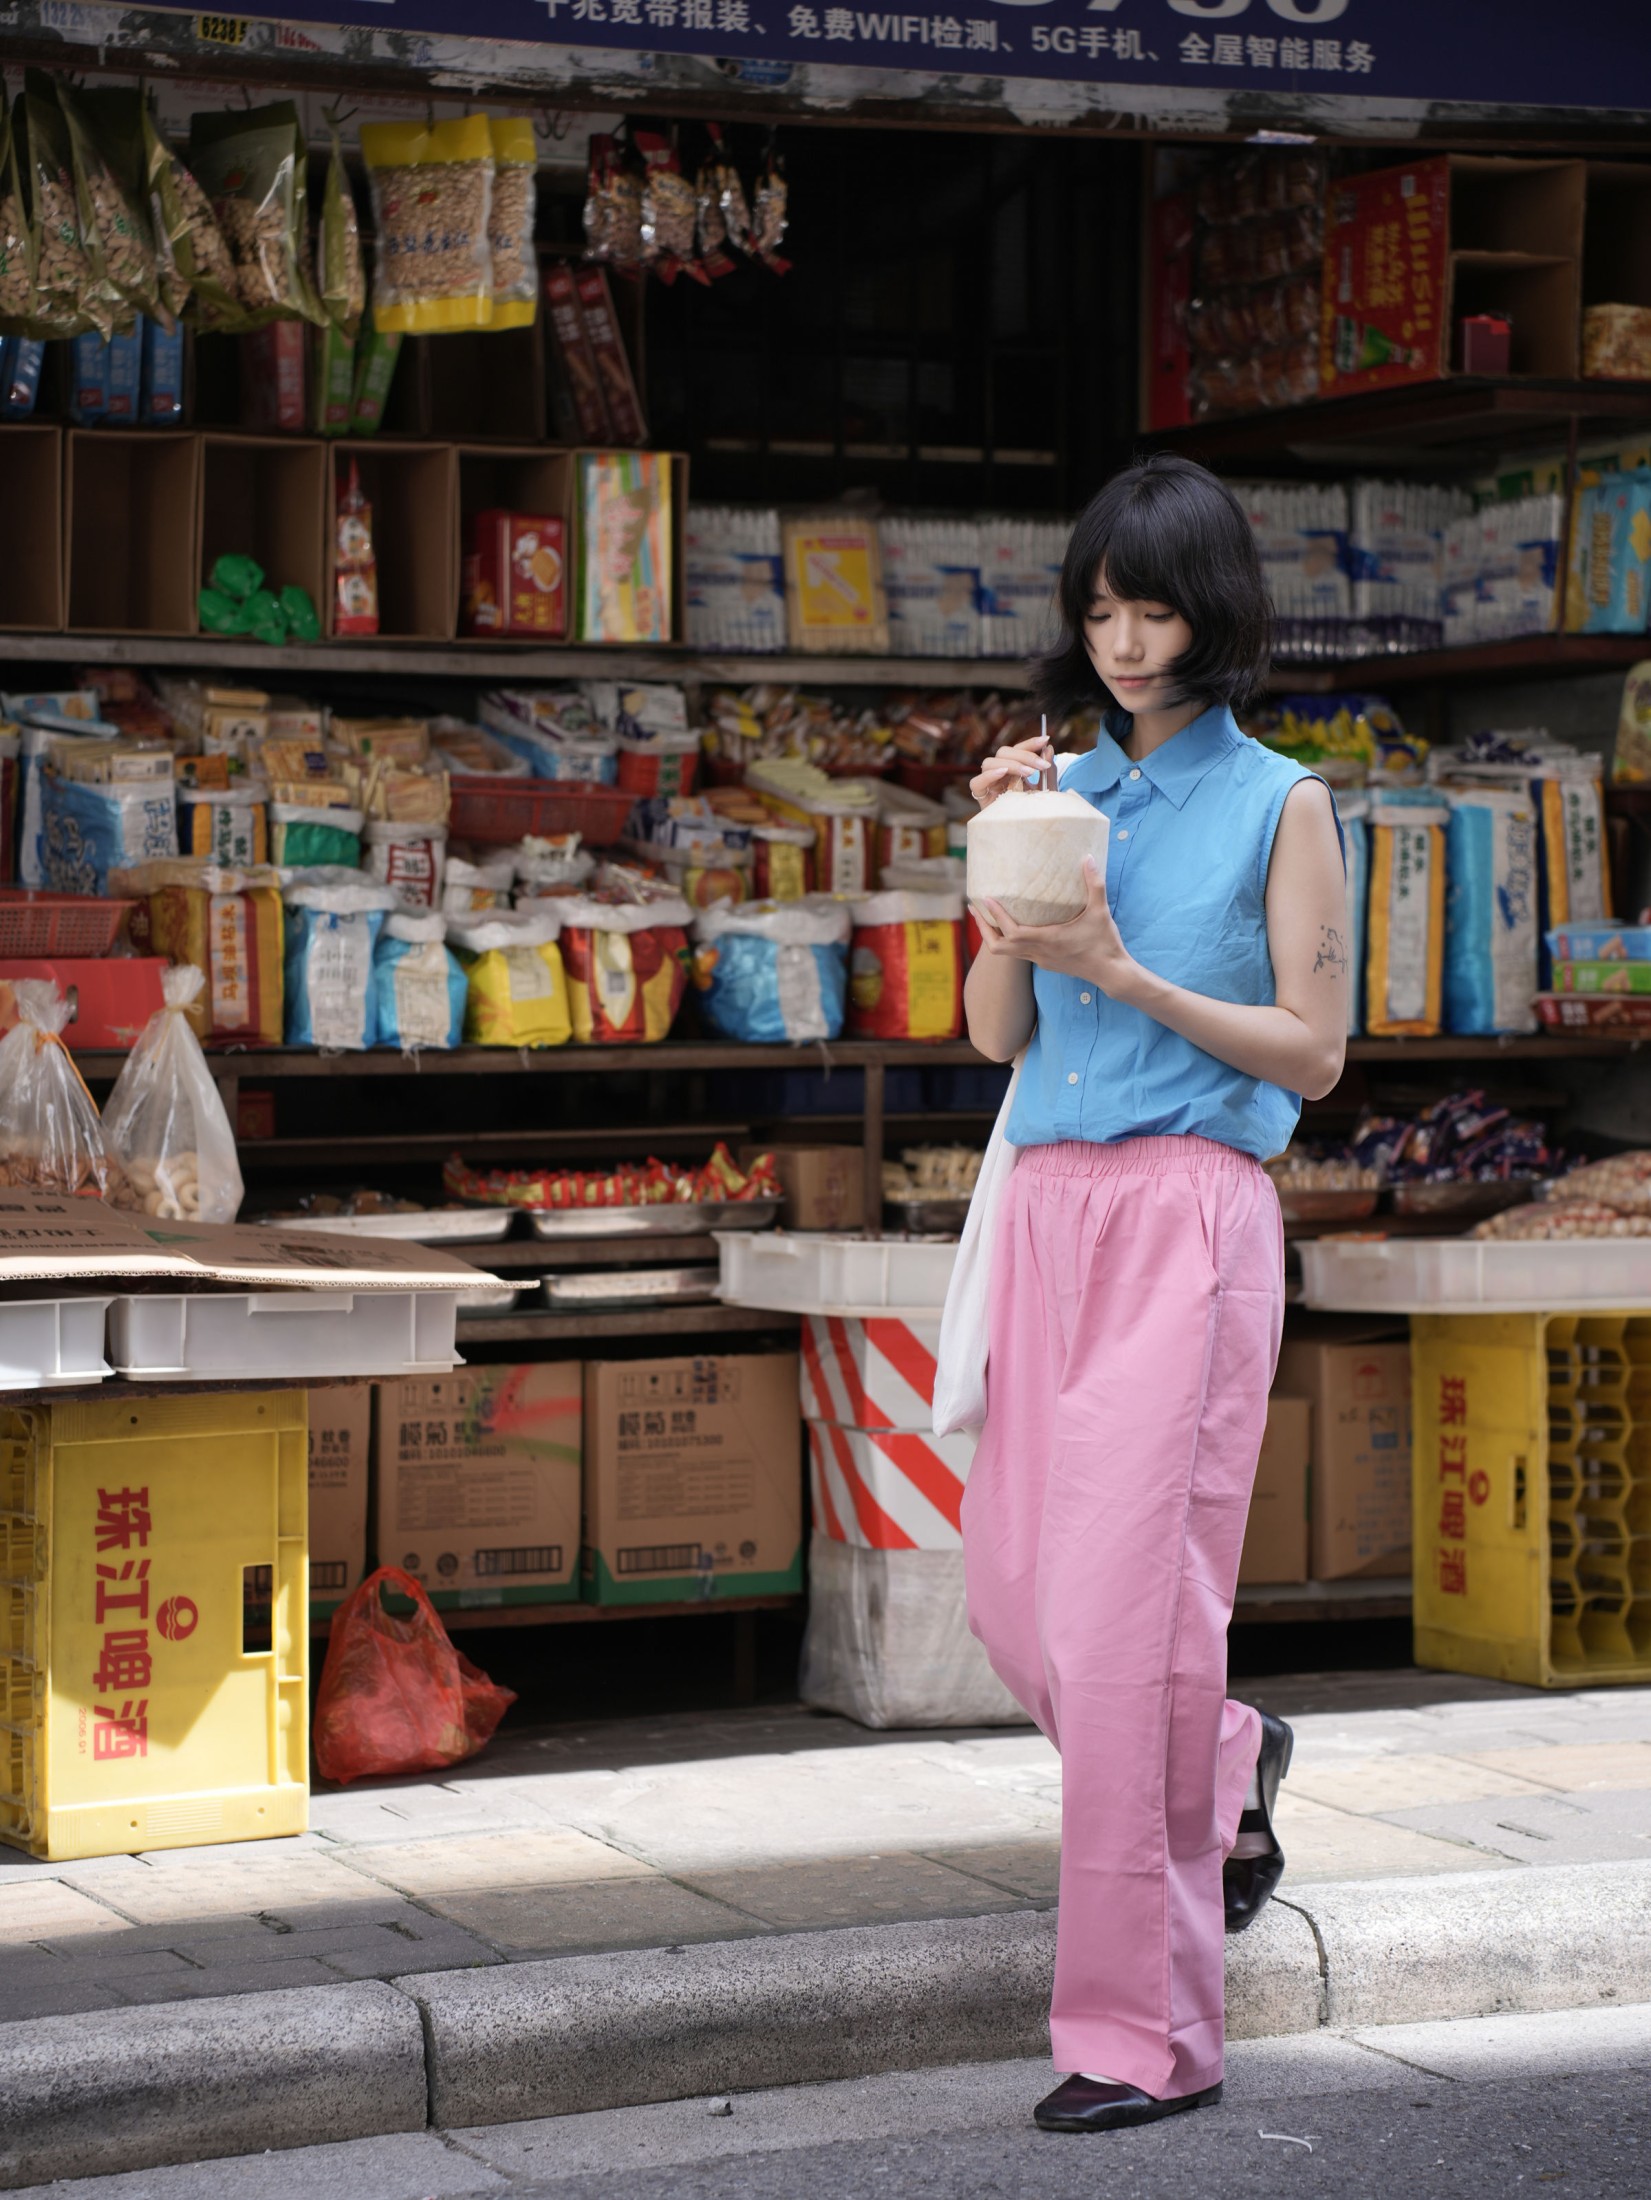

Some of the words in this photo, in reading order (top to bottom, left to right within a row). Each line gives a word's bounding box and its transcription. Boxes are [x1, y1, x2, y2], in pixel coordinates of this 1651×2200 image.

[1438, 1374, 1467, 1595] 珠江啤酒
[93, 1486, 152, 1760] 珠江啤酒
